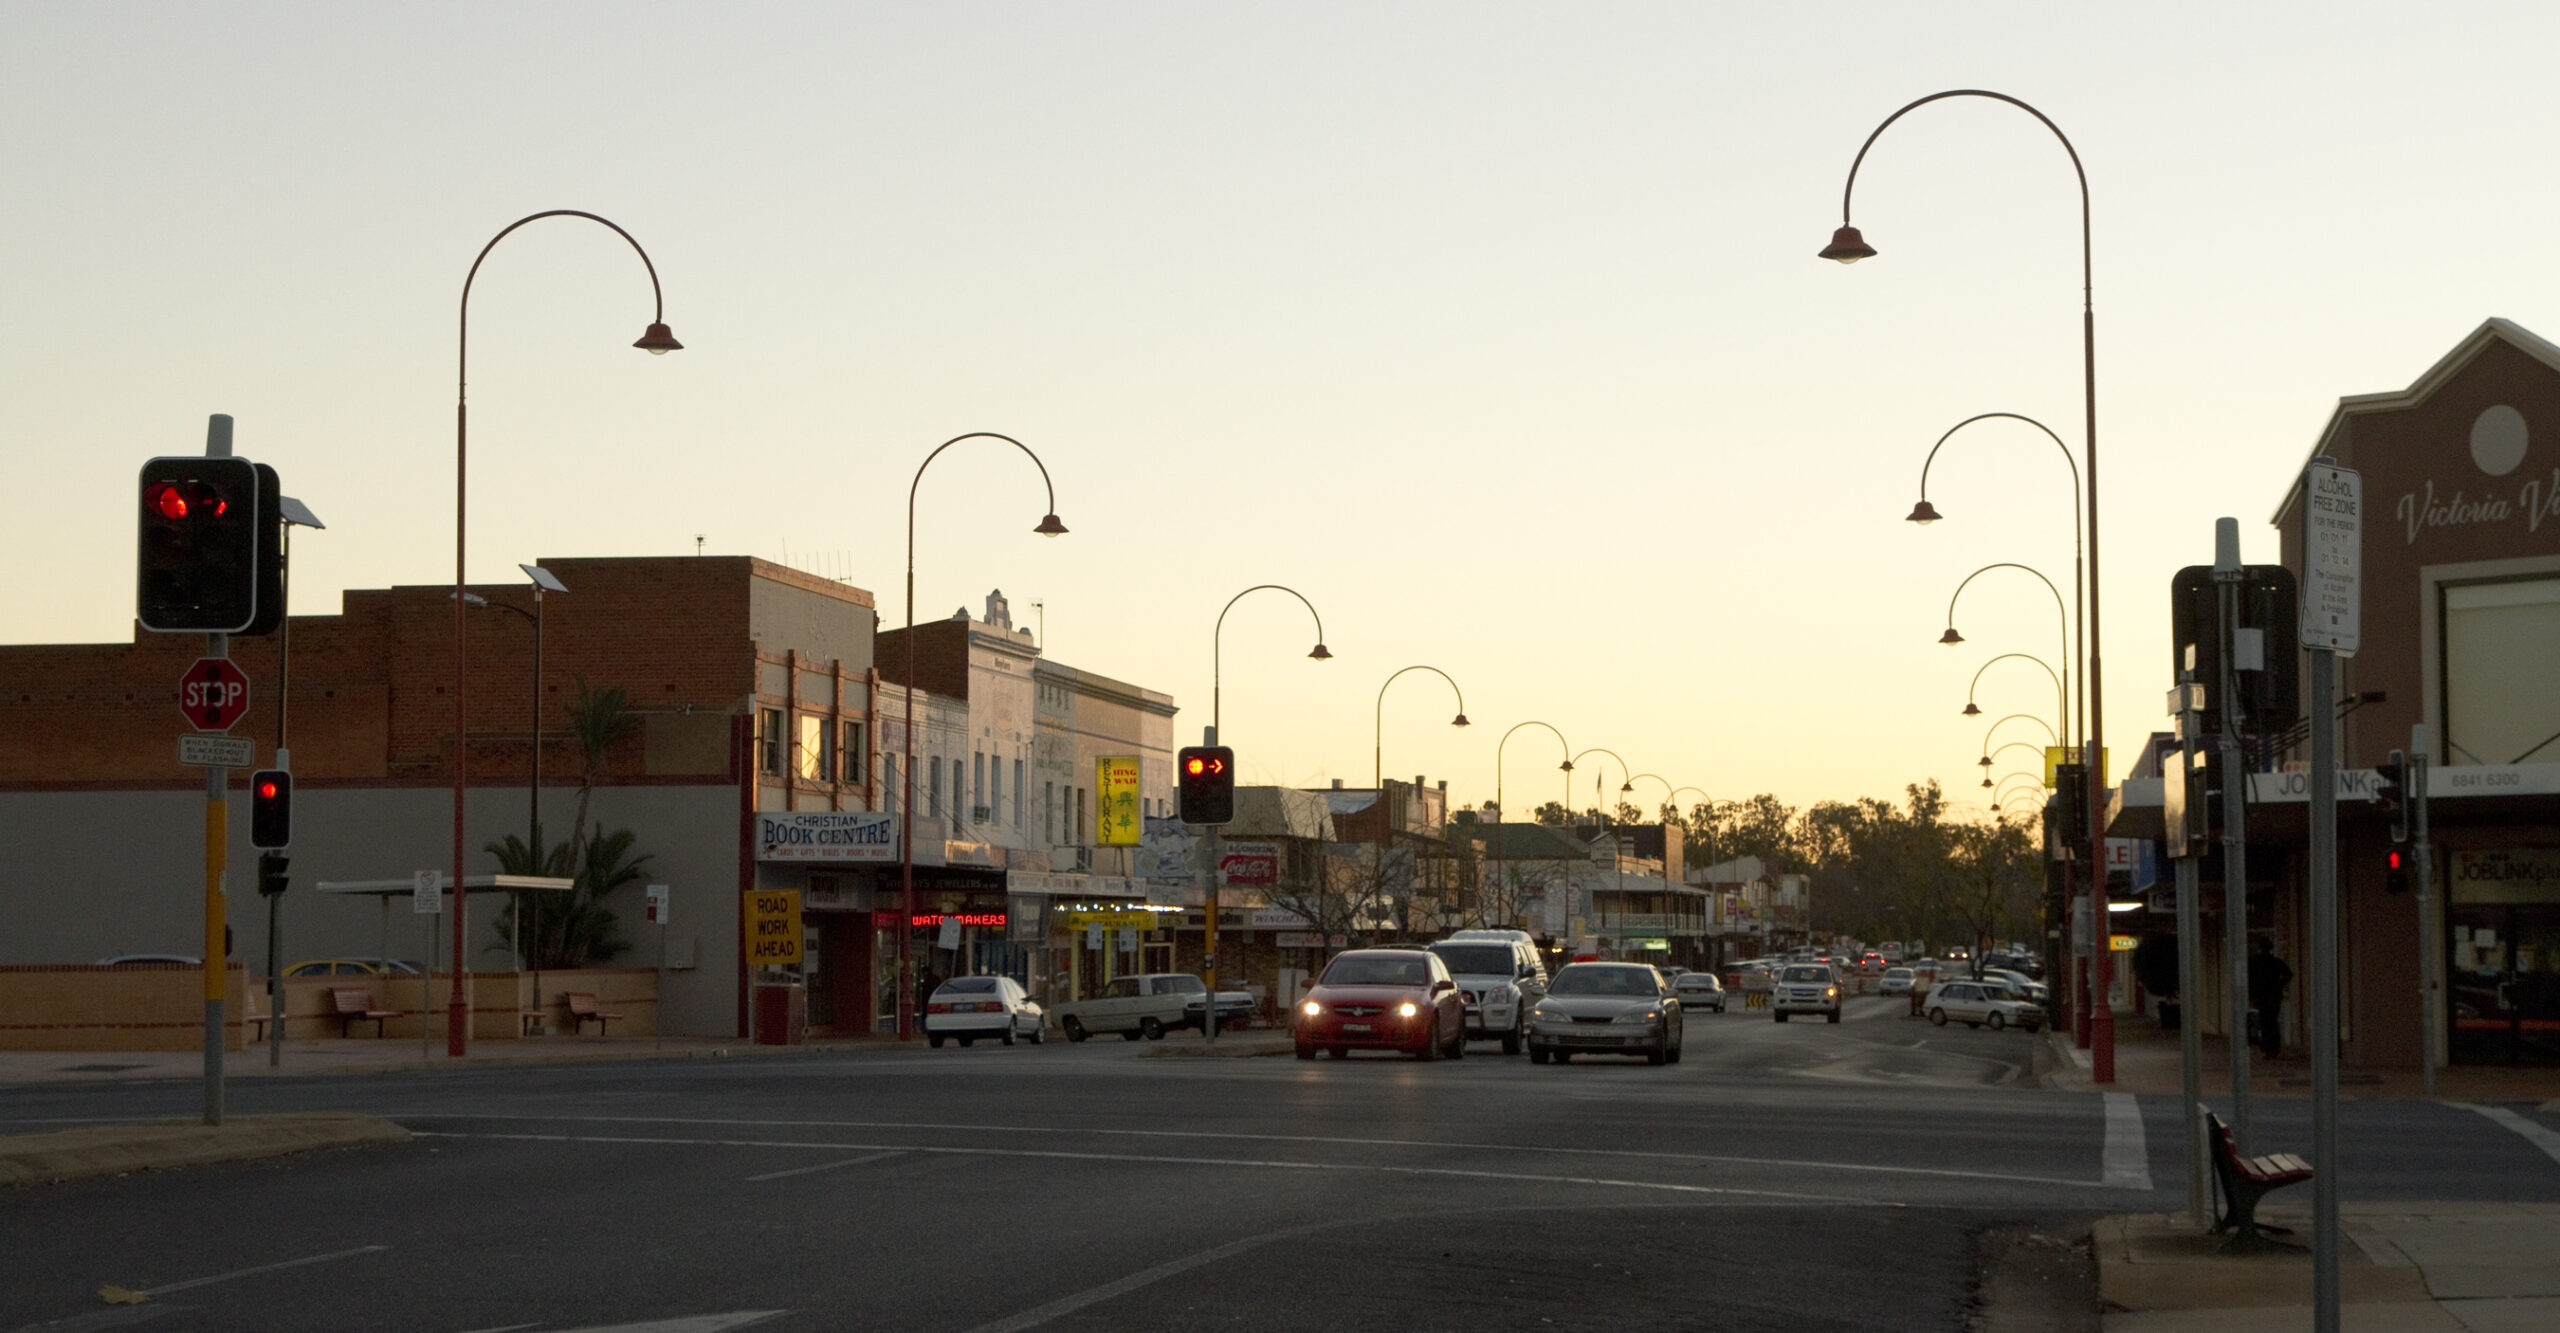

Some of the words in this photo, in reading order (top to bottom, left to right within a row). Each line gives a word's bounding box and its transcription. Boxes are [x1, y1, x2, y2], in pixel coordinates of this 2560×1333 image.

[2318, 478, 2353, 497] ALCOHOL
[2314, 495, 2333, 512] FREE
[2335, 498, 2356, 516] ZONE
[2397, 480, 2511, 545] Victoria
[2314, 516, 2325, 526] FOR
[2327, 518, 2336, 528] THE
[2337, 520, 2355, 531] PERIOD
[186, 682, 244, 707] STOP
[1113, 769, 1137, 777] HING
[1114, 777, 1137, 785] WAH
[2452, 773, 2482, 787] 6841
[2487, 772, 2520, 786] 6300
[1103, 758, 1112, 843] RESTAURANT
[795, 816, 858, 828] CHRISTIAN
[764, 818, 814, 845] BOOK
[817, 818, 891, 845] CENTRE
[777, 848, 794, 857] CARDS
[800, 848, 815, 857] GIFTS
[822, 848, 840, 857] BIBLES
[846, 848, 865, 857] BOOKS
[871, 848, 889, 857] MUSIC
[935, 879, 982, 889] JEWELLERS
[757, 897, 788, 914] ROAD
[757, 919, 790, 936] WORK
[912, 914, 1006, 926] WATCMAKERS
[754, 941, 794, 958] AHEAD
